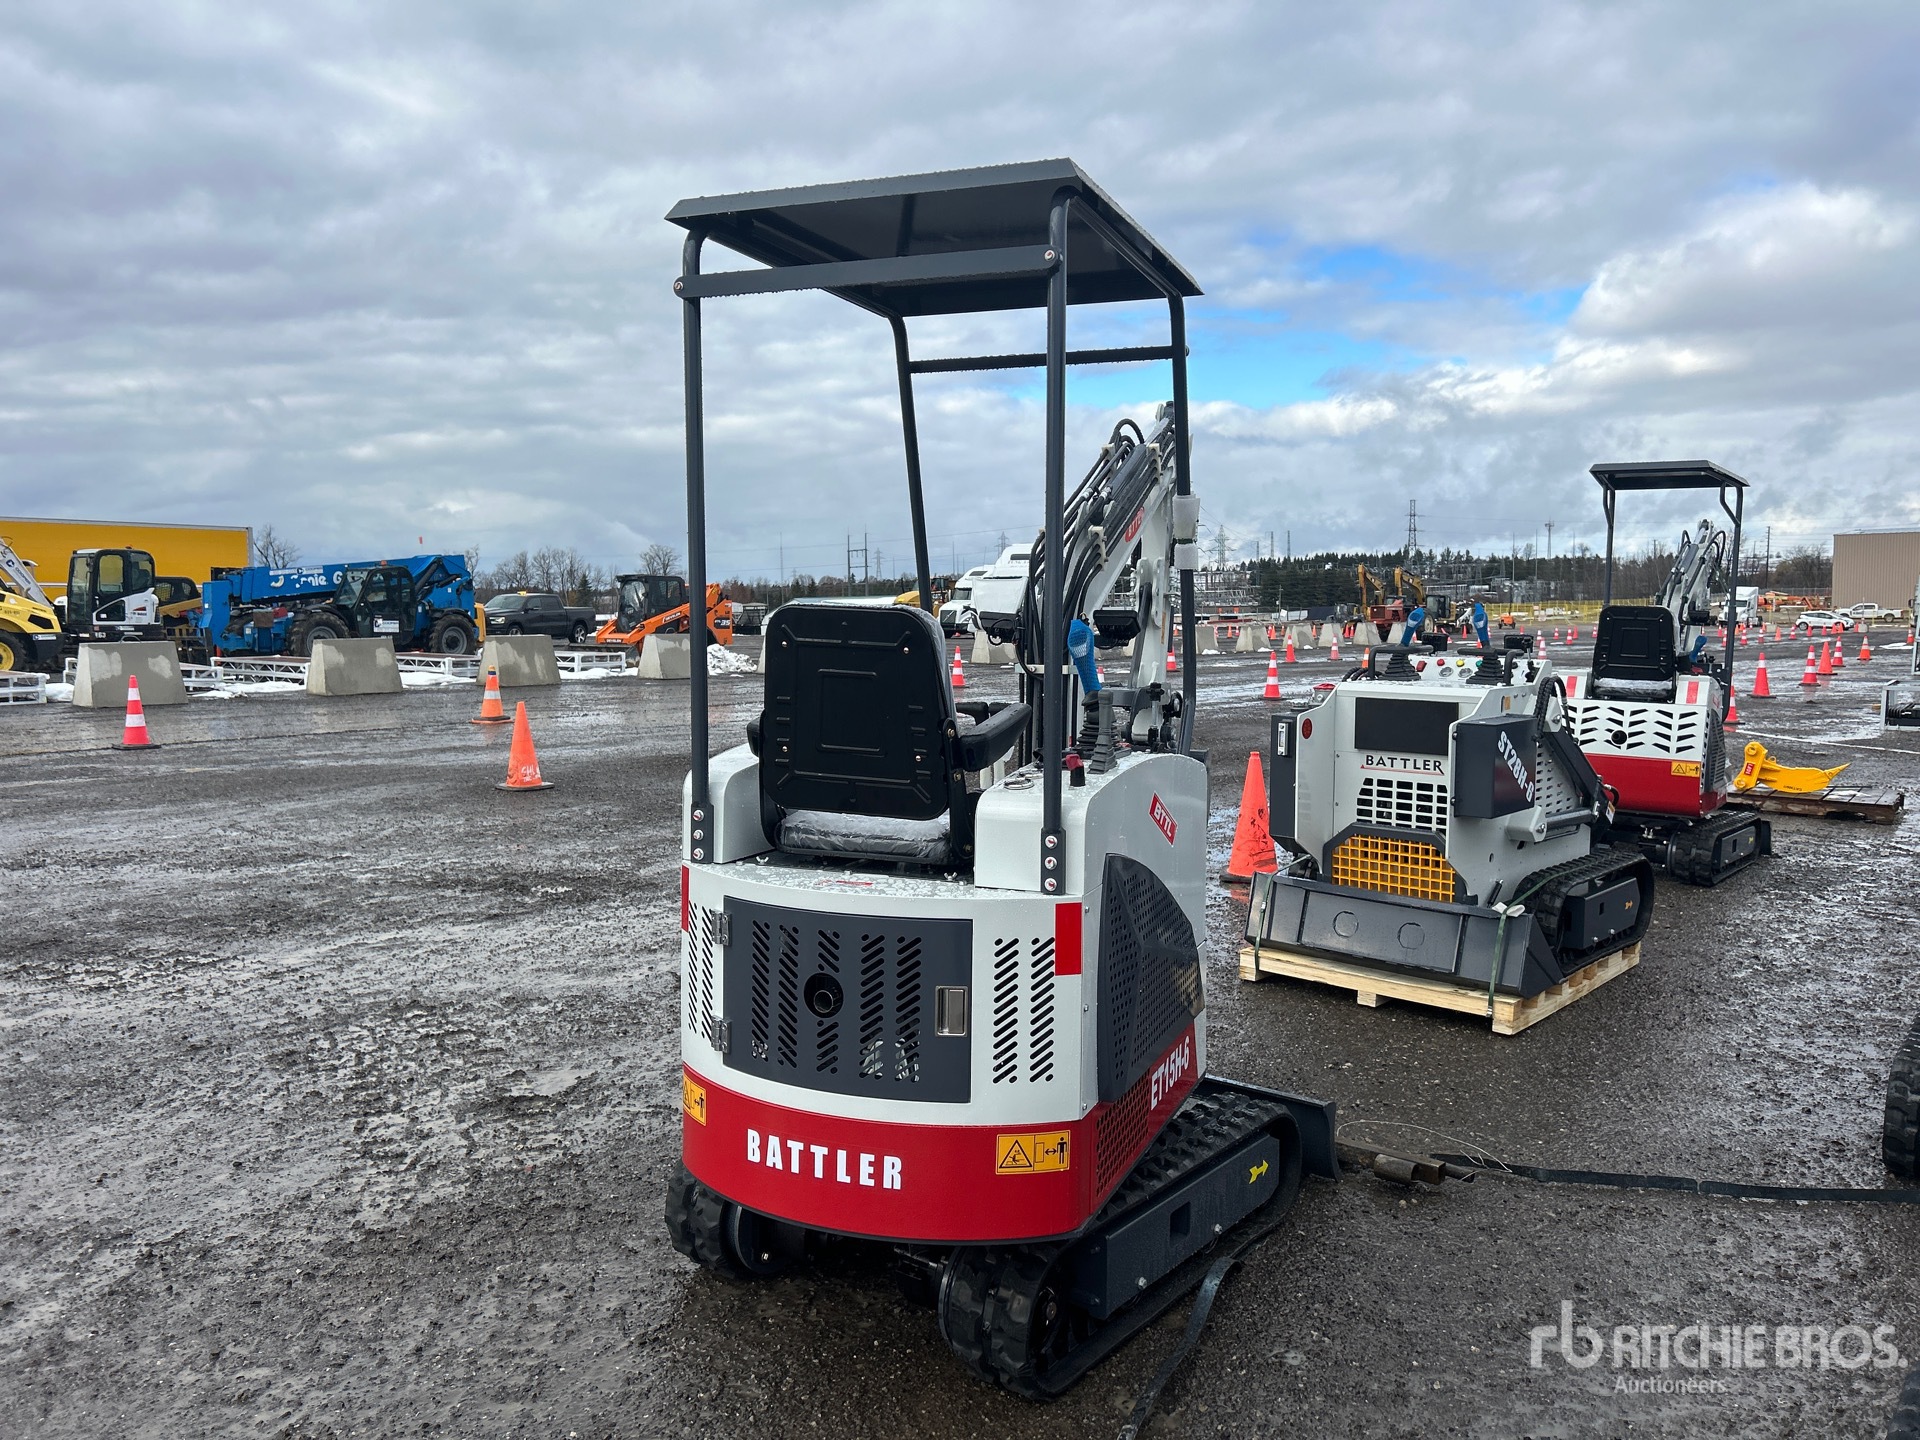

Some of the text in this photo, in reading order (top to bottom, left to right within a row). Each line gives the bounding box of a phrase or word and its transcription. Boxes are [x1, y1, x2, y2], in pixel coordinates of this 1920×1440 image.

[1365, 754, 1445, 775] BATTLER
[1497, 731, 1535, 802] ST28H-6
[1153, 801, 1173, 838] BTTL
[1151, 1035, 1190, 1111] ET15H-6
[747, 1128, 903, 1190] BATTLER
